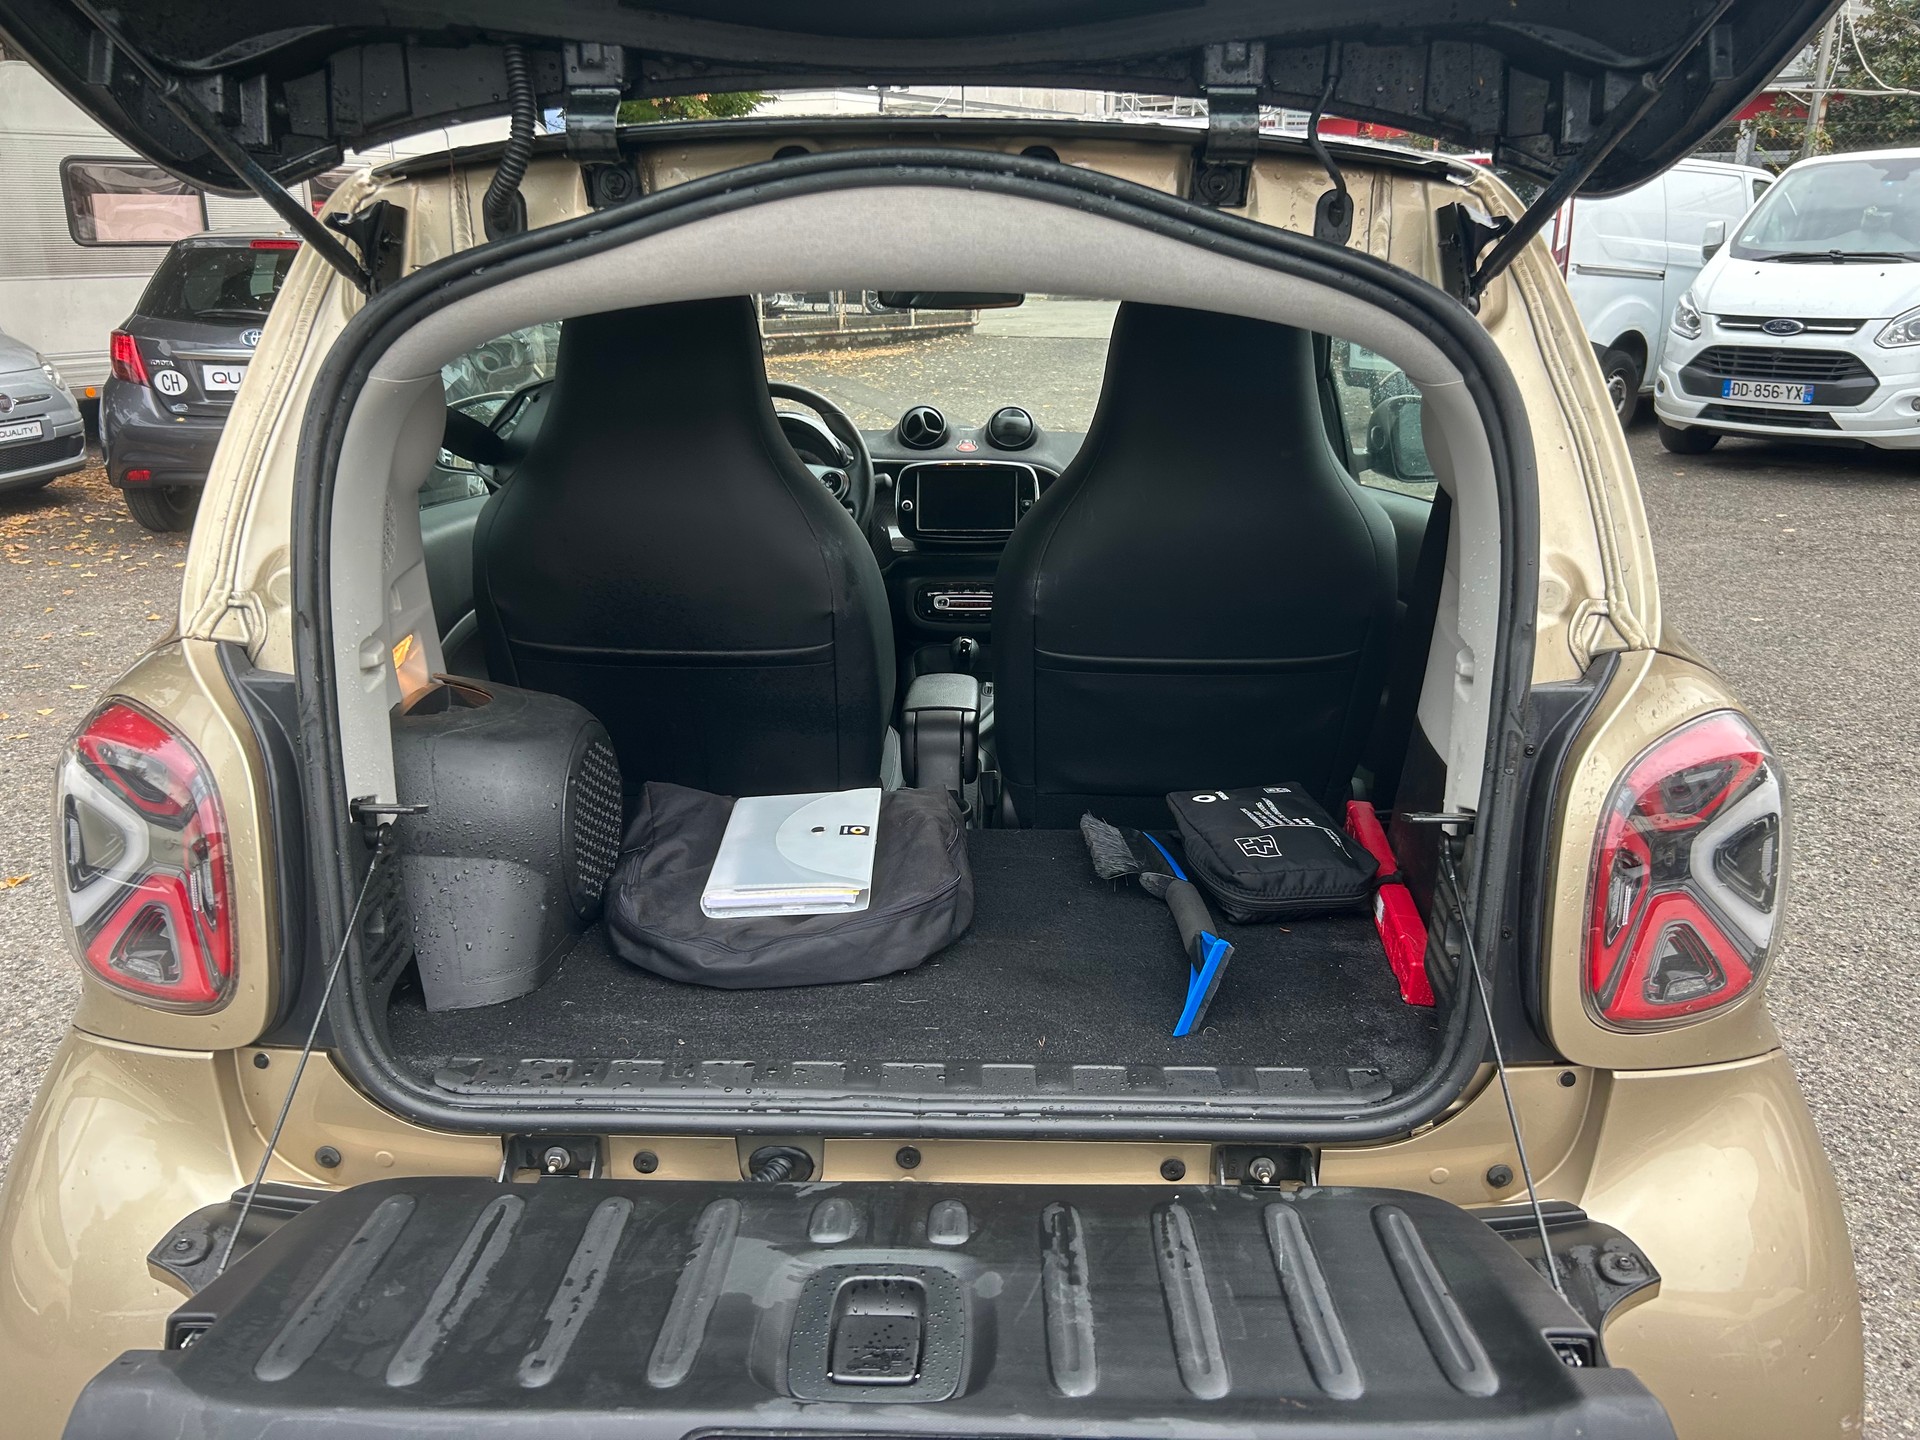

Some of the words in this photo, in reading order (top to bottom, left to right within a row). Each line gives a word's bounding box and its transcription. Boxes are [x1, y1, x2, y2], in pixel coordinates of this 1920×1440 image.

[150, 359, 175, 367] TOYOTA
[161, 374, 181, 391] CH
[1732, 382, 1804, 400] DD-856-YX
